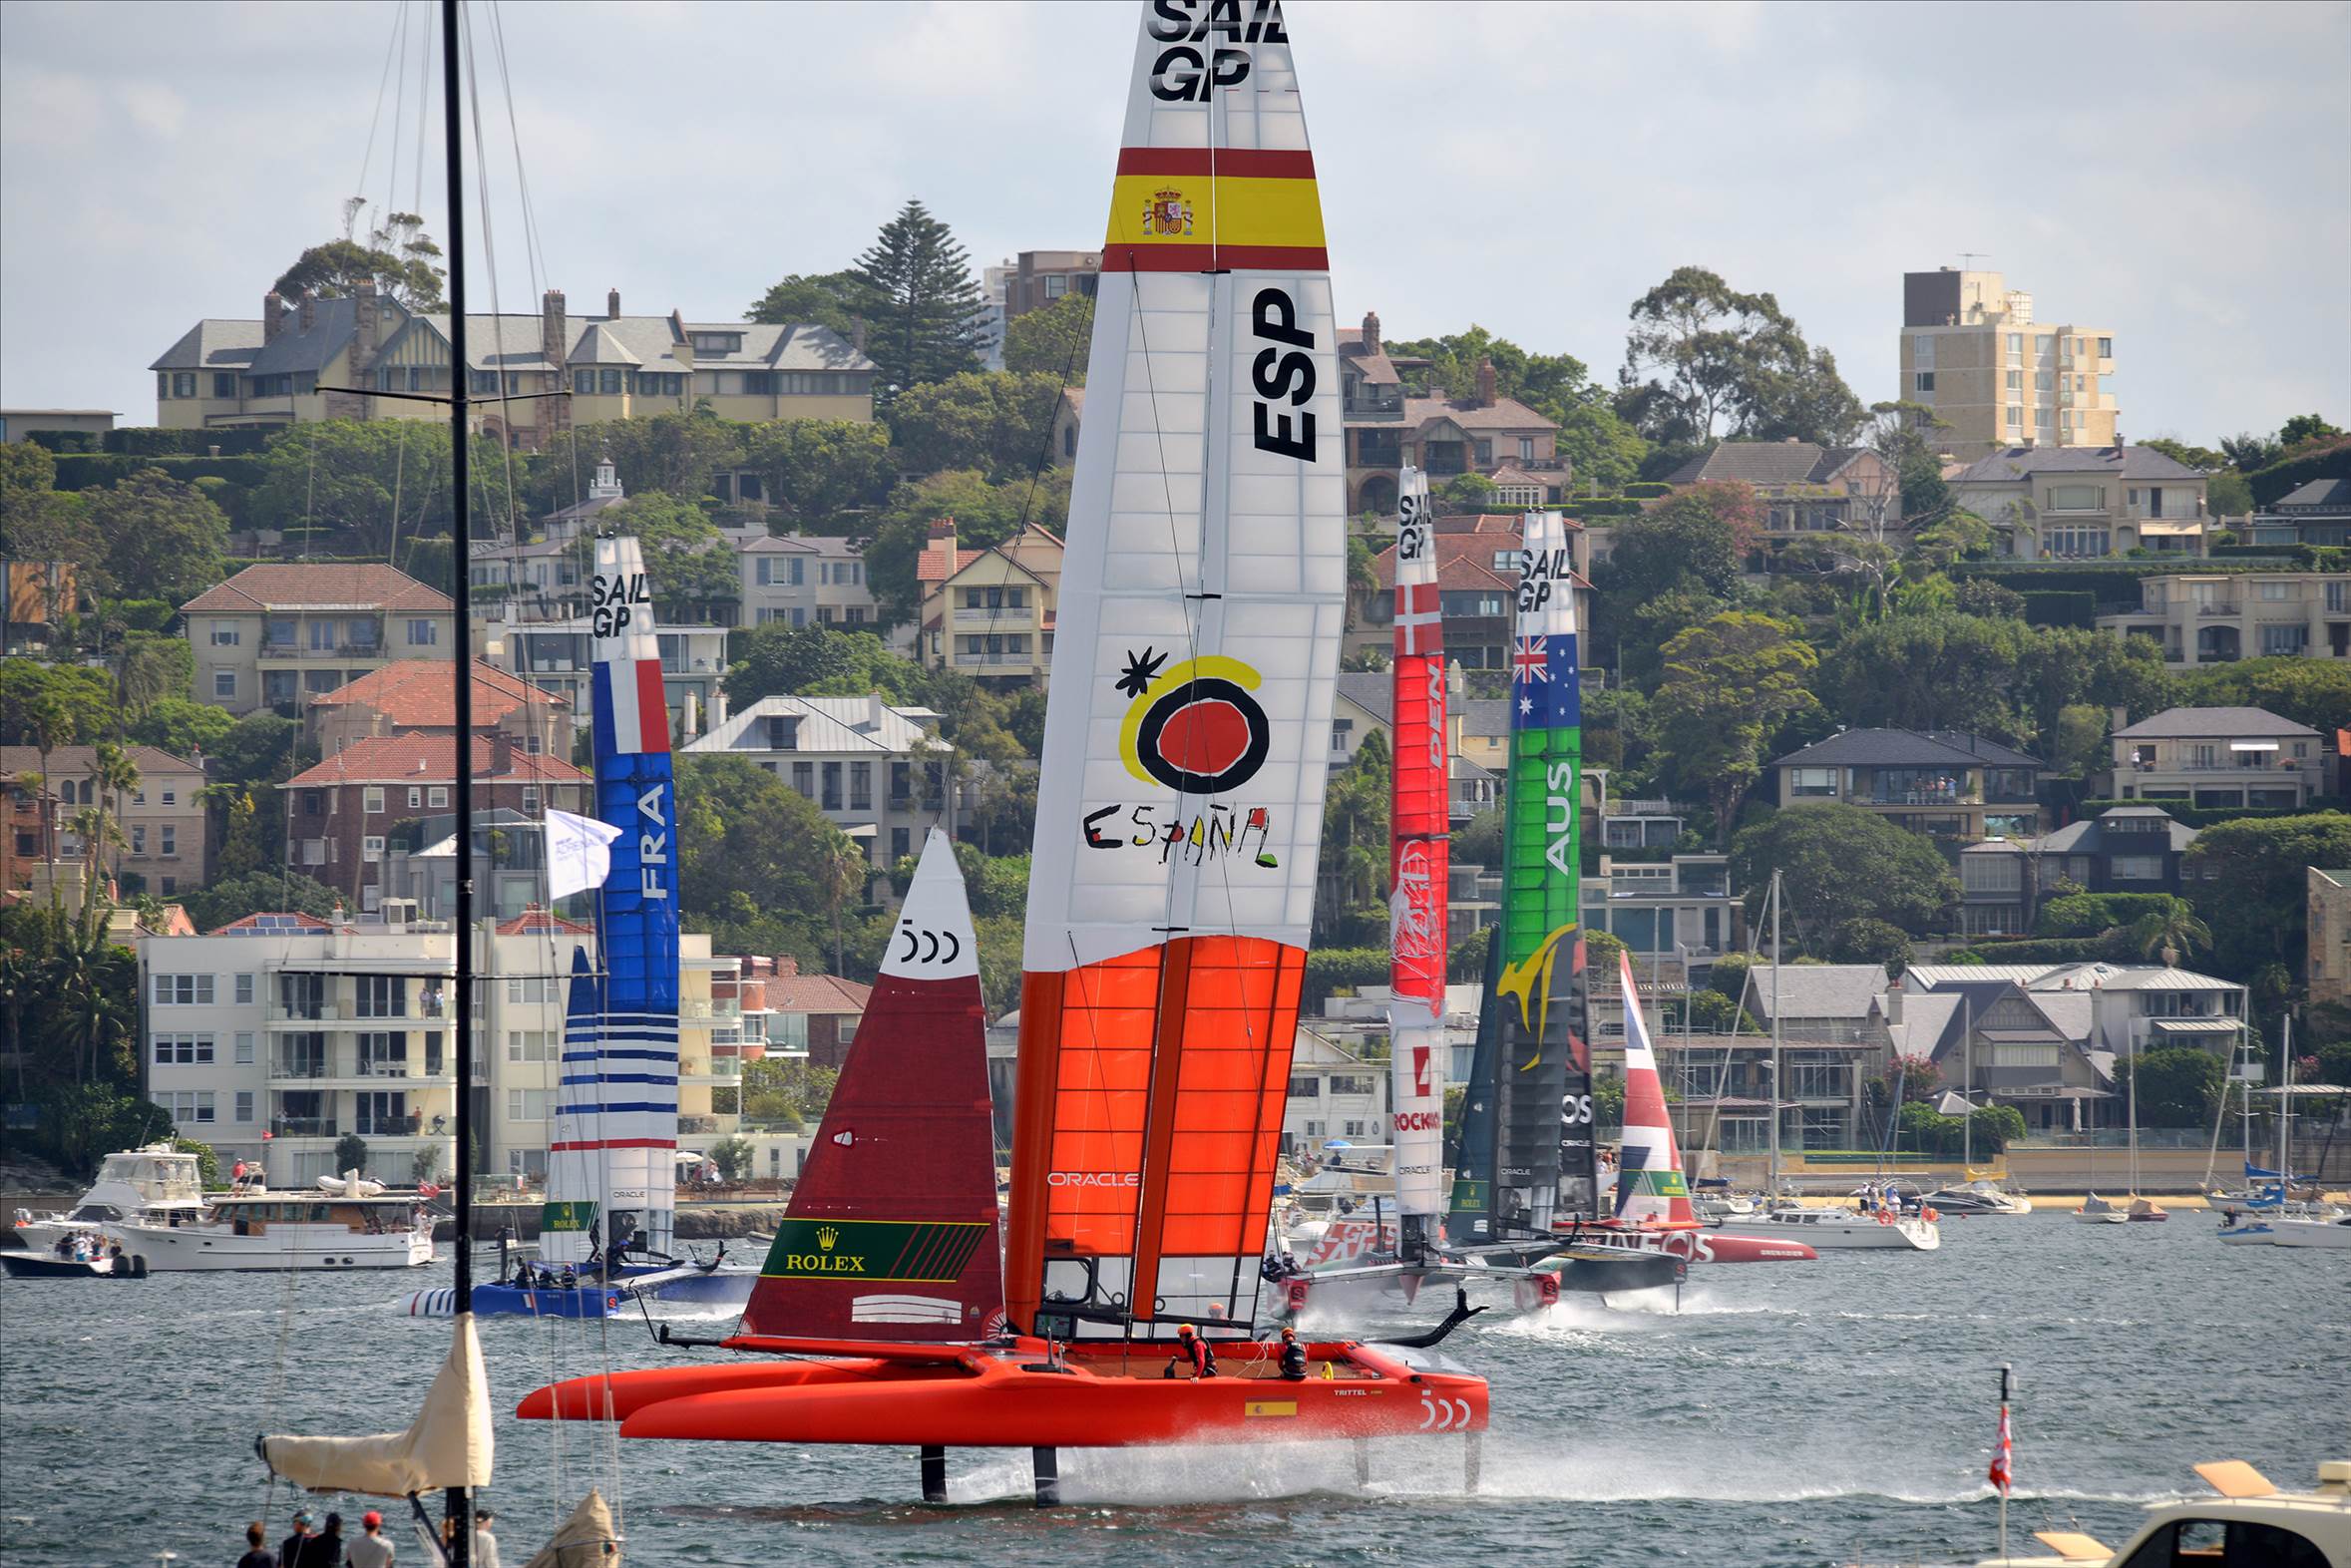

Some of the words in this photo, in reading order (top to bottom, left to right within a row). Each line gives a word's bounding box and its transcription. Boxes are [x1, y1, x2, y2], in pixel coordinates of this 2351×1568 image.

[1147, 0, 1289, 43] SAIL
[1149, 47, 1252, 102] GP
[1252, 287, 1317, 463] ESP
[1520, 549, 1570, 581] SAIL
[591, 574, 650, 606] SAIL
[1517, 581, 1551, 613] GP
[592, 606, 630, 638] GP
[1427, 664, 1442, 769] DEN
[1546, 761, 1573, 877] AUS
[637, 784, 668, 899] FRA
[1047, 1172, 1139, 1187] ORACLE
[785, 1253, 866, 1273] ROLEX
